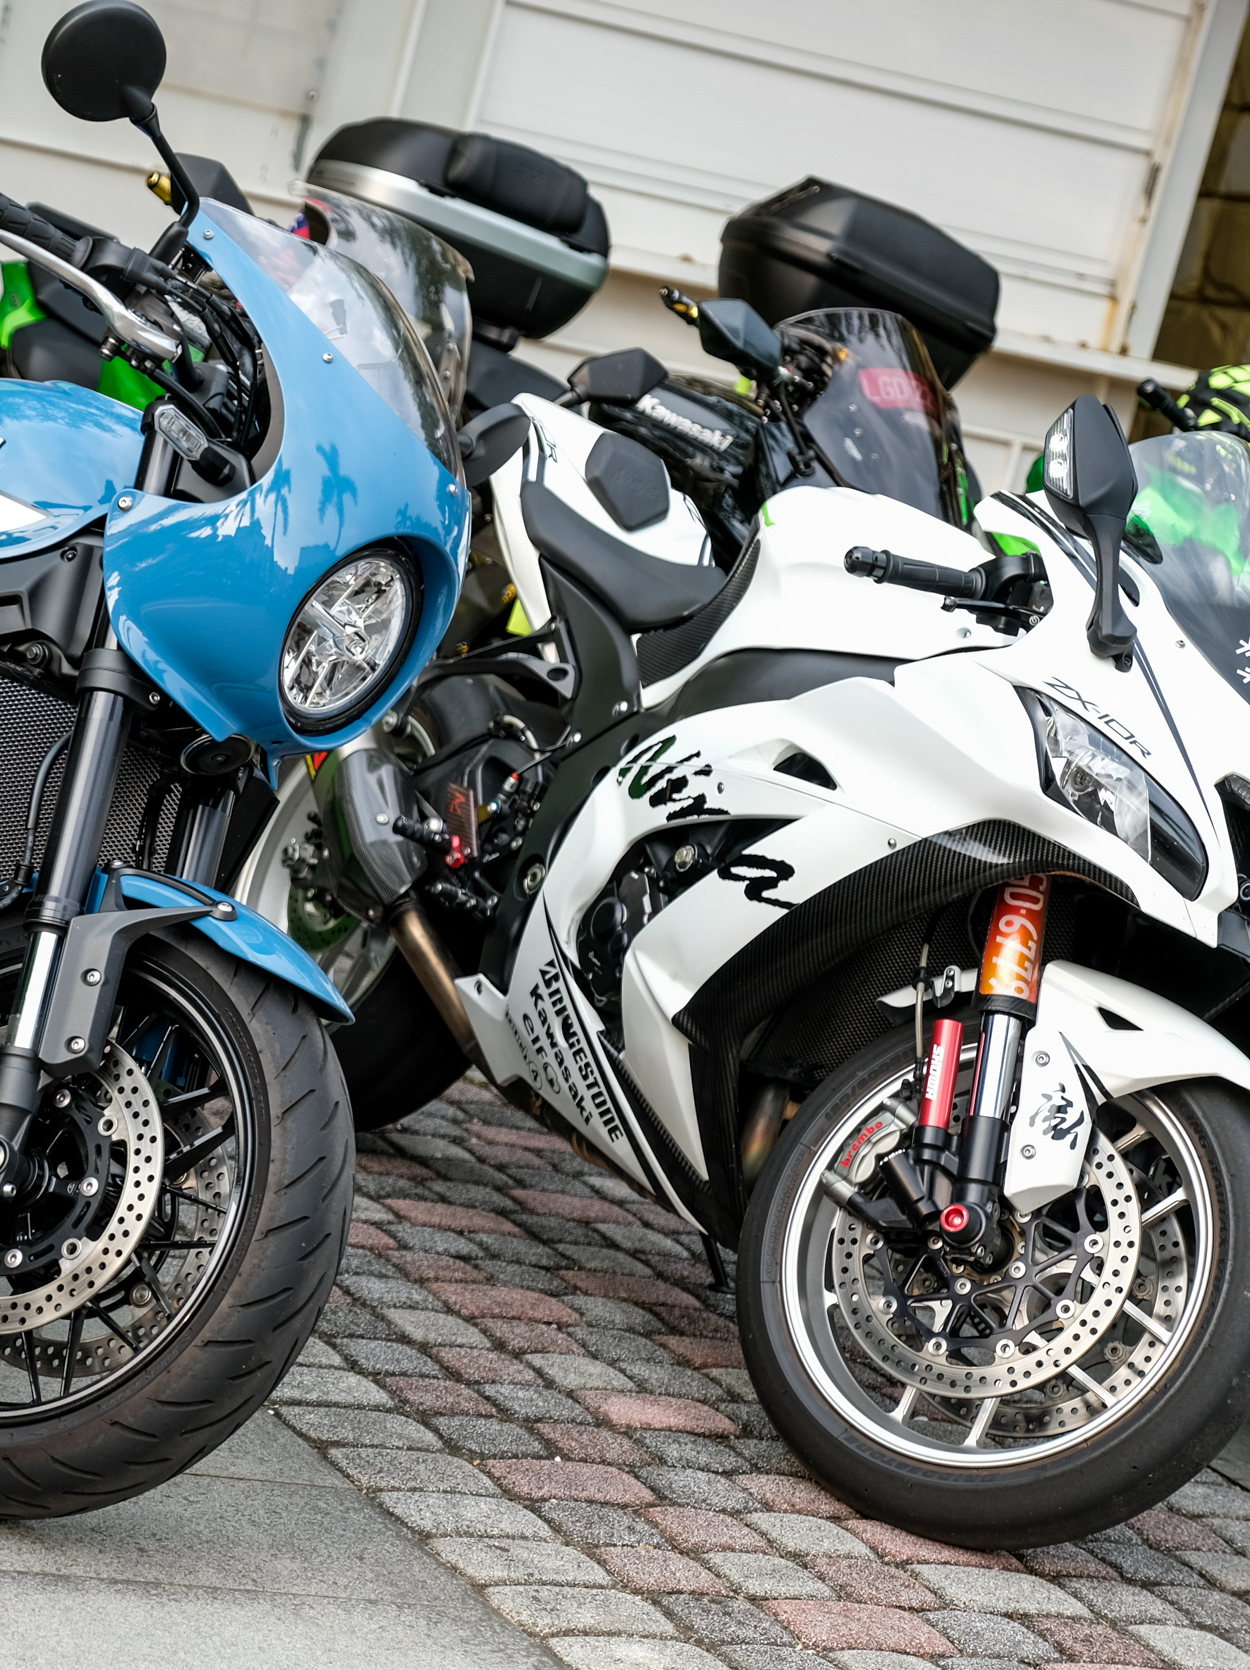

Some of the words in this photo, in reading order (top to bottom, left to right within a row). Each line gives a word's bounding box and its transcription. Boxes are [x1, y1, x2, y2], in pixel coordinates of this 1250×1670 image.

[635, 394, 734, 452] Kawasaki
[1042, 676, 1152, 760] ZX-10R
[530, 983, 593, 1126] Kawasaki
[925, 1043, 945, 1101] SHOWA
[840, 1121, 883, 1167] brembo
